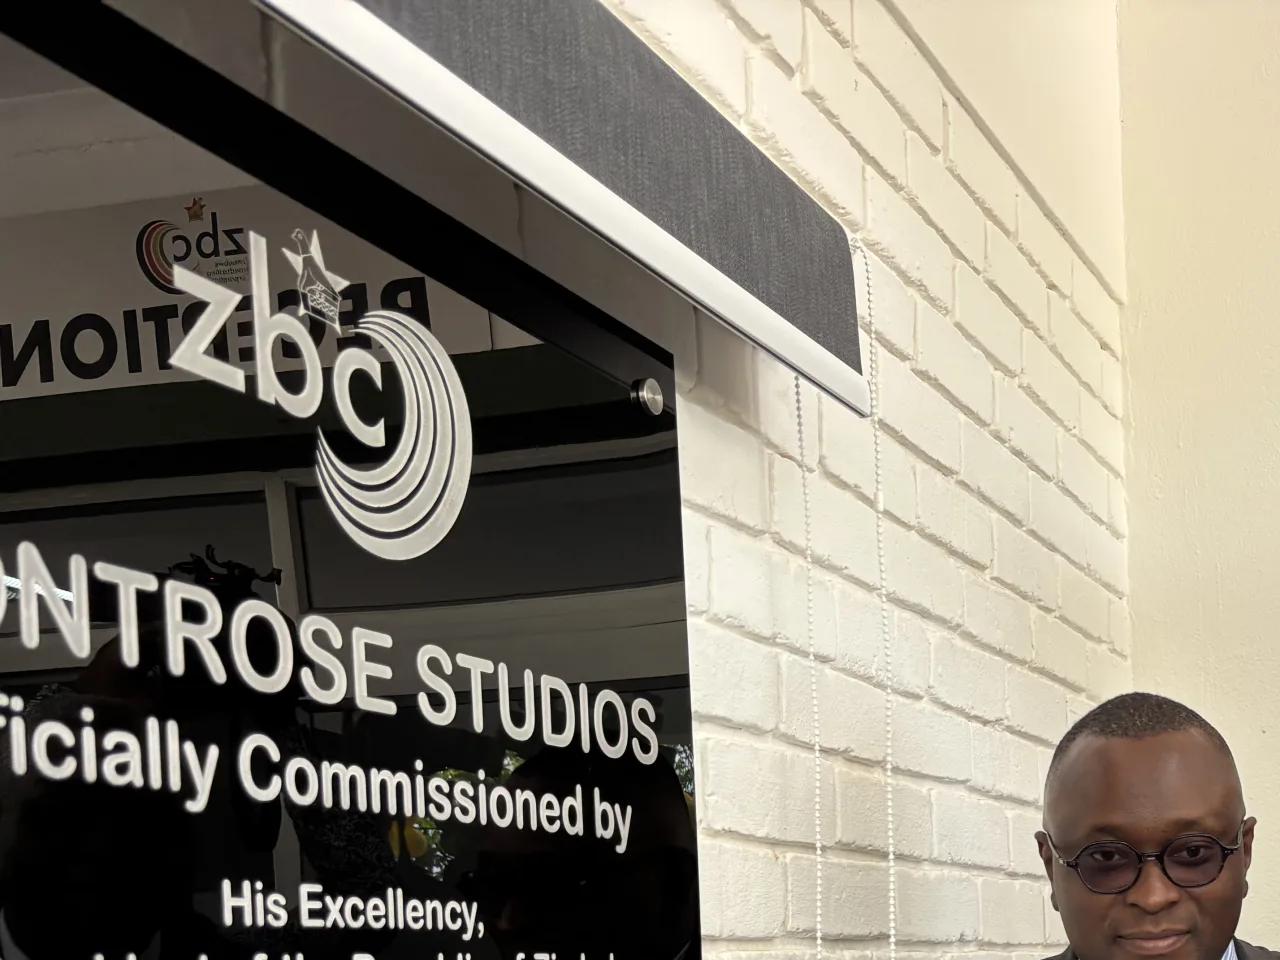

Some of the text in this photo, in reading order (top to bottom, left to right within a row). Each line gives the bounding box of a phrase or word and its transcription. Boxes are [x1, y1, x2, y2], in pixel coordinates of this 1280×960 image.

[168, 230, 386, 447] zbc
[0, 541, 659, 765] NTROSE STUDIOS
[0, 692, 633, 854] icially Commissioned by
[221, 878, 485, 941] His Excellency,
